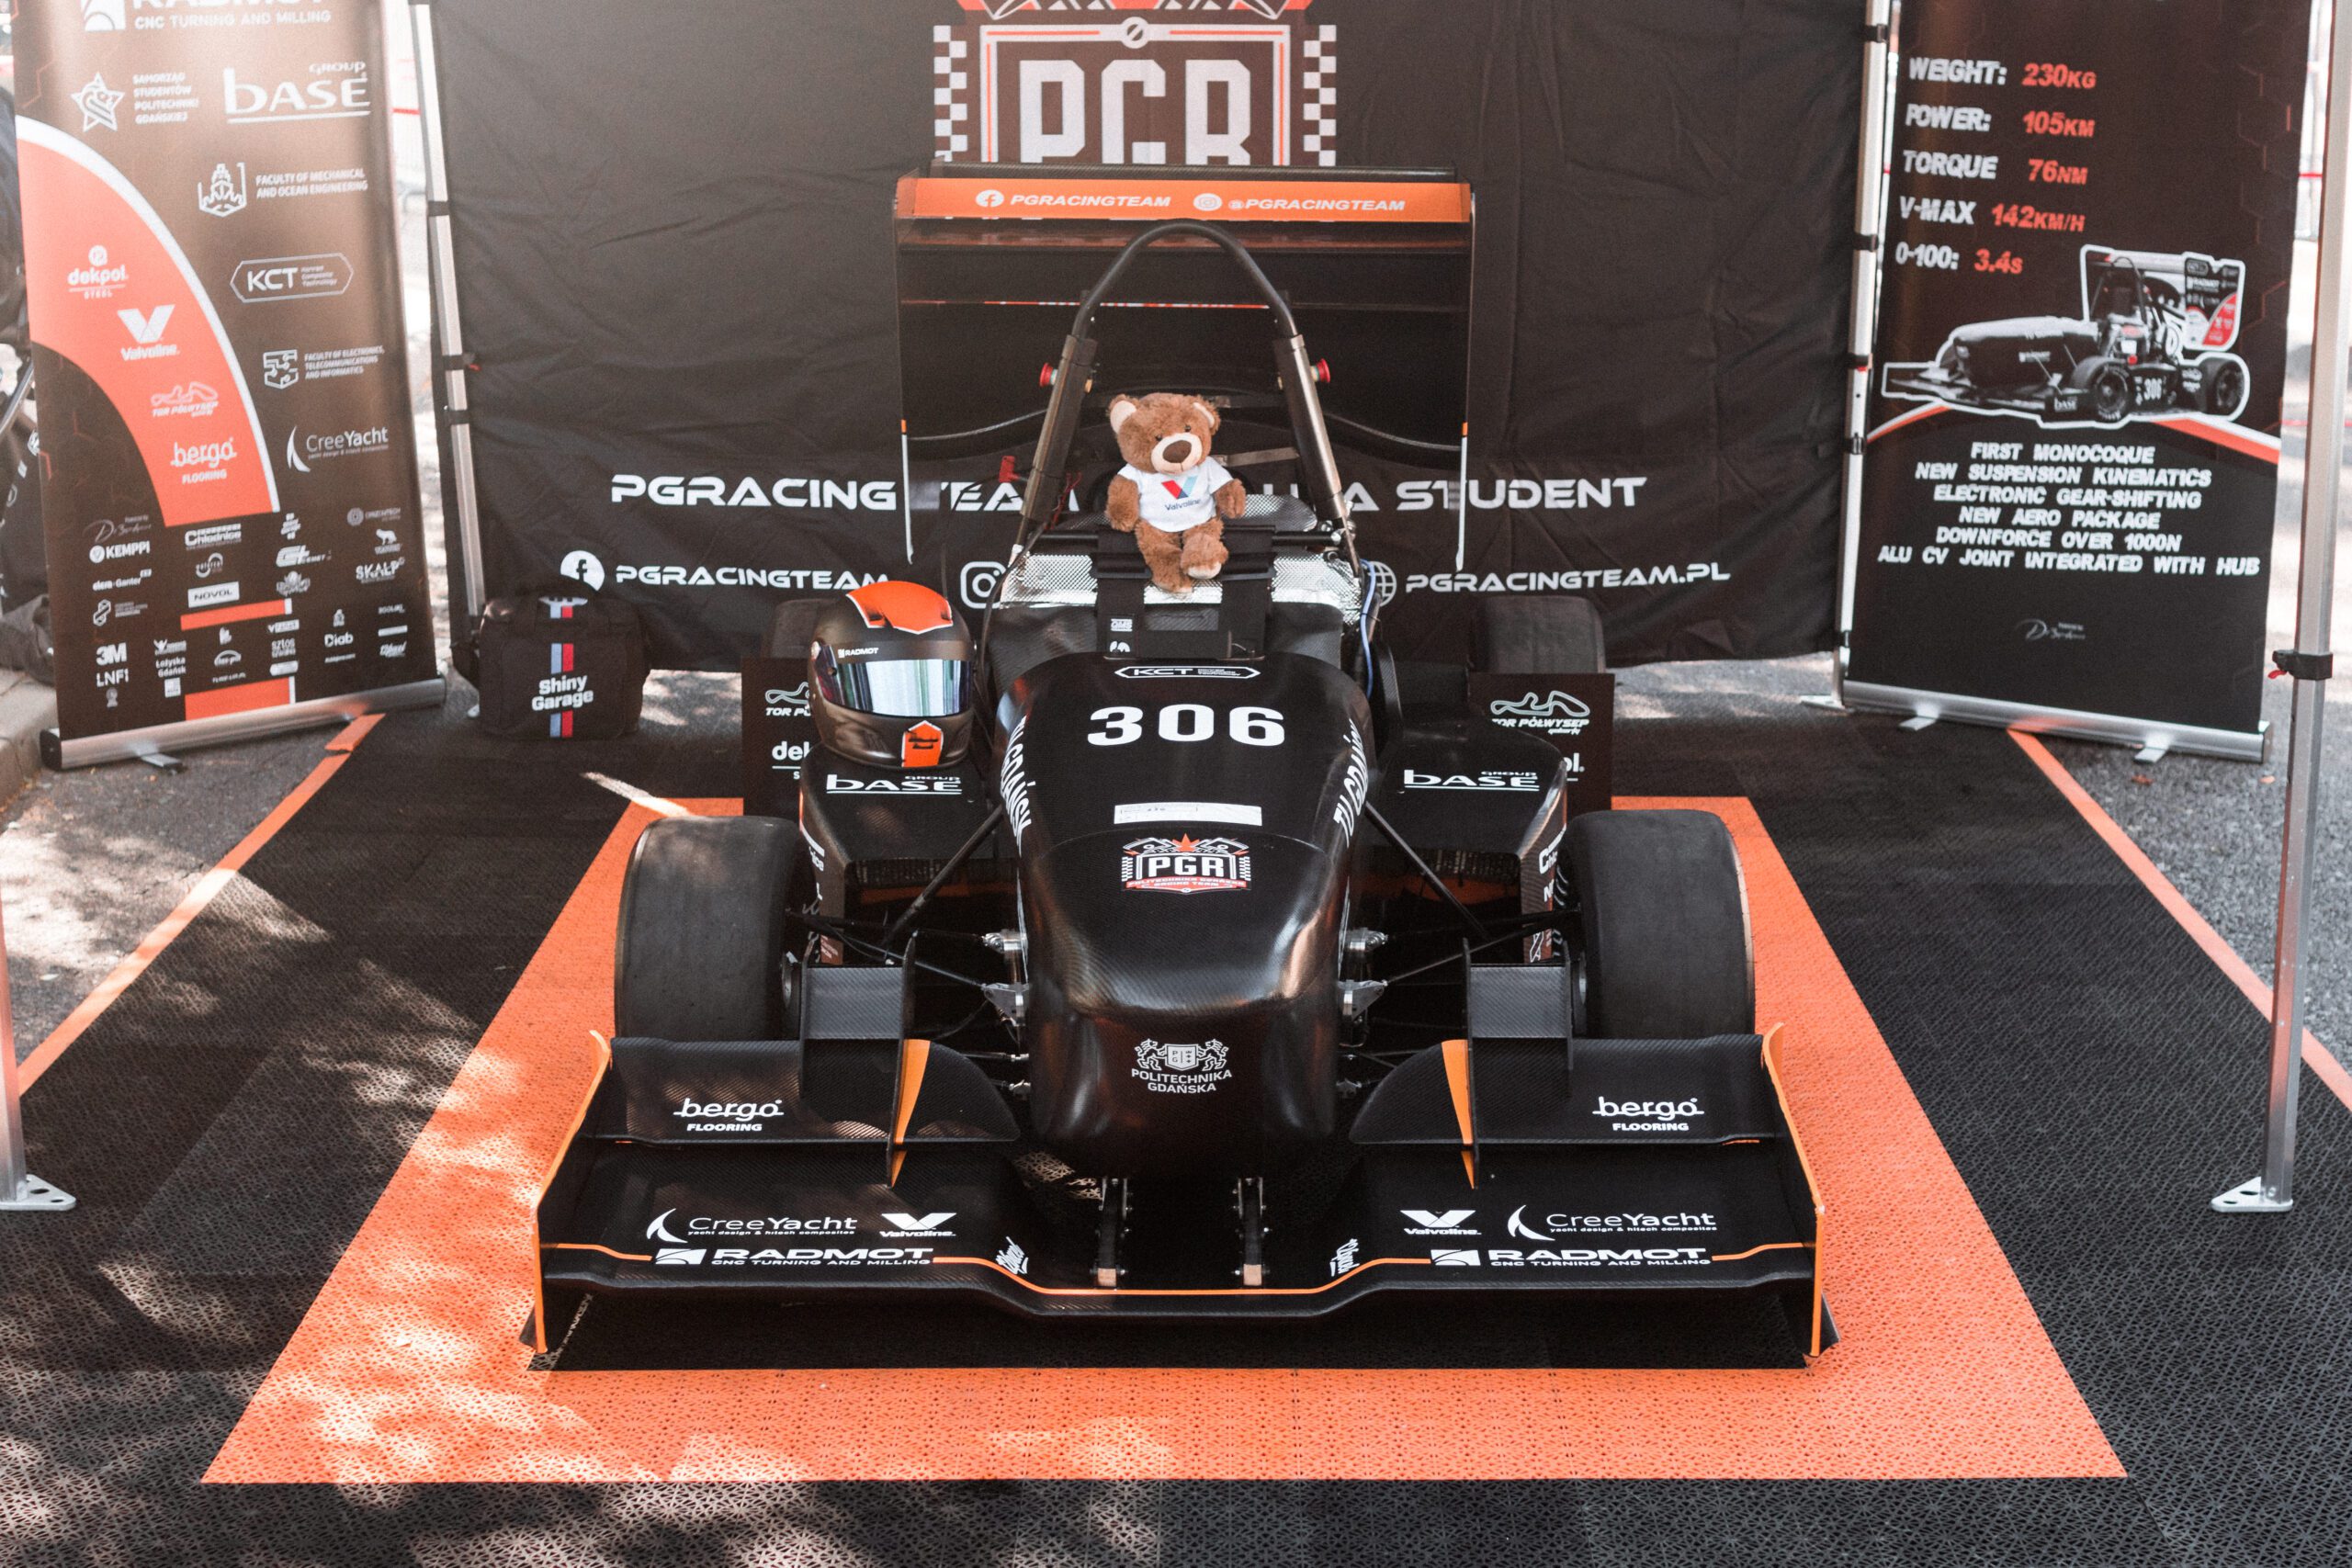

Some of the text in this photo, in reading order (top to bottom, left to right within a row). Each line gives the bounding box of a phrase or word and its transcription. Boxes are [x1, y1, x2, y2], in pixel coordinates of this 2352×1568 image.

[135, 10, 332, 29] CNC TURNING AND MILLING
[1908, 57, 2097, 89] WEIGHT: 230KG
[1905, 103, 2095, 137] POWER: 105KM
[255, 168, 365, 186] FACULTY OF MECHANICAL
[1903, 150, 2088, 185] TORQUE 76NM
[256, 180, 368, 198] AND OCEAN ENGINEERING
[1011, 194, 1170, 208] PGRACINGTEAM
[1899, 196, 2086, 232] V-MAX 142KM/H
[1895, 242, 1959, 270] 0-100:
[247, 267, 298, 292] KCT
[121, 344, 176, 361] Valvoline
[304, 351, 332, 362] FACULTY
[306, 426, 390, 452] CreeYacht
[170, 435, 237, 468] bergo
[1971, 443, 2155, 464] FIRST MONOCOQUE
[182, 468, 227, 484] FLOORING
[1915, 462, 2212, 487] NEW SUSPENSION KINEMATICS
[611, 474, 897, 511] PGRACING
[1396, 477, 1647, 512] STUDENT
[1934, 484, 2202, 509] ELECTRONIC GEAR-SHIFTING
[1959, 507, 2161, 530] NEW AERO PACKAGE
[1936, 526, 2182, 552] DOWNFORCE OVER 1000N
[106, 540, 150, 559] KEMPPI
[1877, 546, 2260, 576] ALU CV JOINT INTEGRATED WITH HUB
[1406, 562, 1731, 593] PGRACINGTEAM.PL
[194, 589, 232, 601] NOVOL
[324, 632, 354, 648] Diab
[96, 642, 127, 666] 3M
[844, 648, 879, 656] RADMOT
[539, 675, 588, 695] Shiny
[531, 690, 594, 711] Garage
[765, 706, 792, 716] TOR
[1087, 704, 1285, 747] 306
[1519, 716, 1590, 728] PÓŁWYSEP
[1148, 856, 1225, 877] PGR
[1131, 1068, 1232, 1084] POLITECHNIKA
[1148, 1082, 1216, 1094] GDAŃSKA
[689, 1217, 857, 1230] CreeYacht
[1546, 1213, 1716, 1226] CreeYacht
[713, 1248, 933, 1259] RADMOT
[1488, 1248, 1706, 1260] RADMOT
